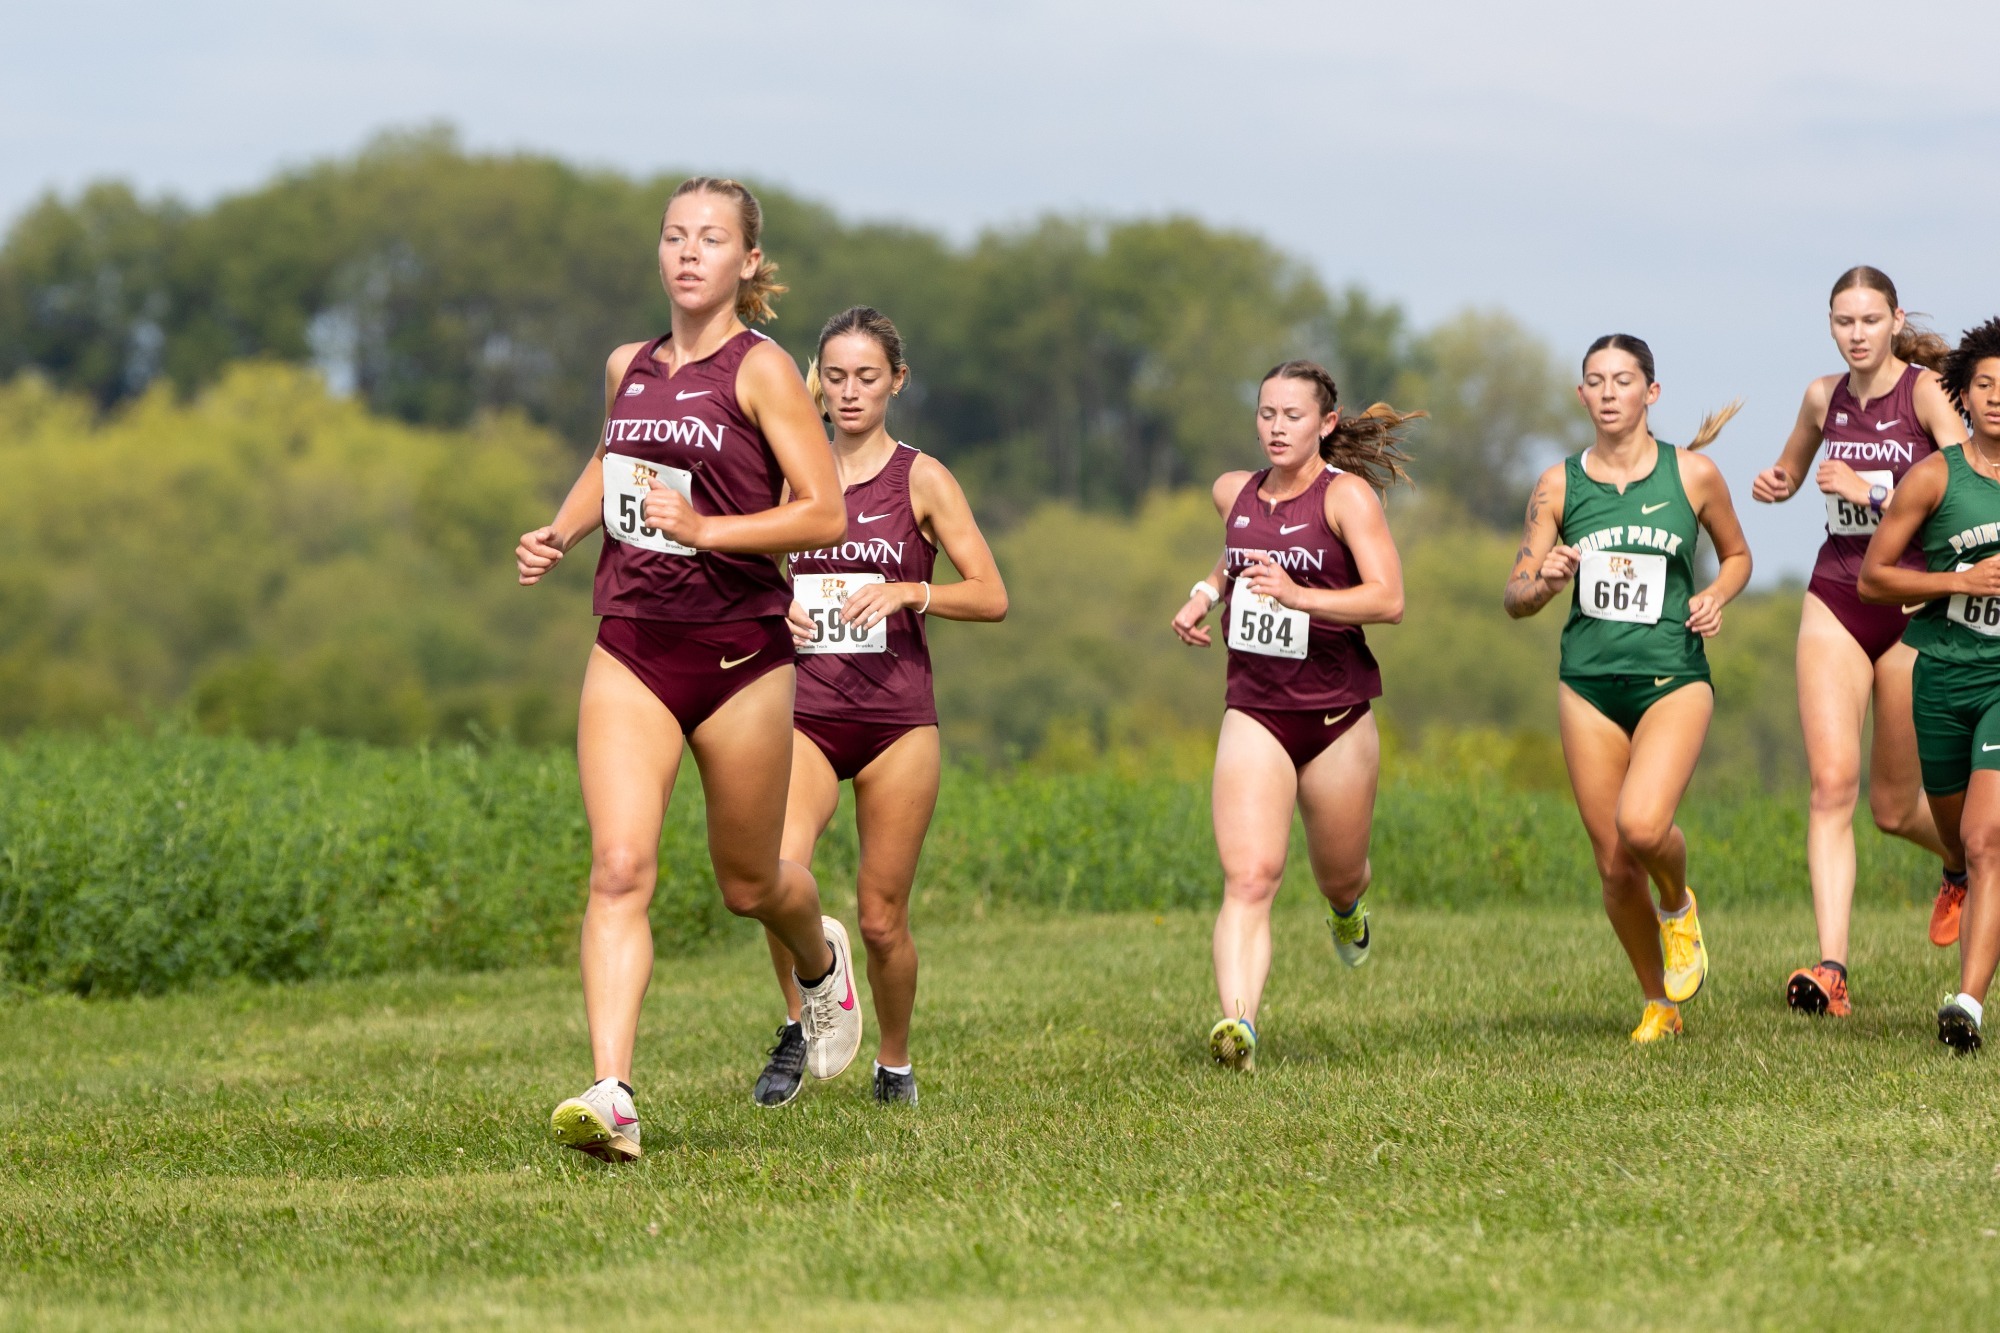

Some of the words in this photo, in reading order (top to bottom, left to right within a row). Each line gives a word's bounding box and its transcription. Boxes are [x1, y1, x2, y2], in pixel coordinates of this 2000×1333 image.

[1627, 525, 1683, 556] PARK
[1948, 522, 2000, 554] POIN
[1594, 581, 1649, 612] 664
[1240, 610, 1293, 647] 584
